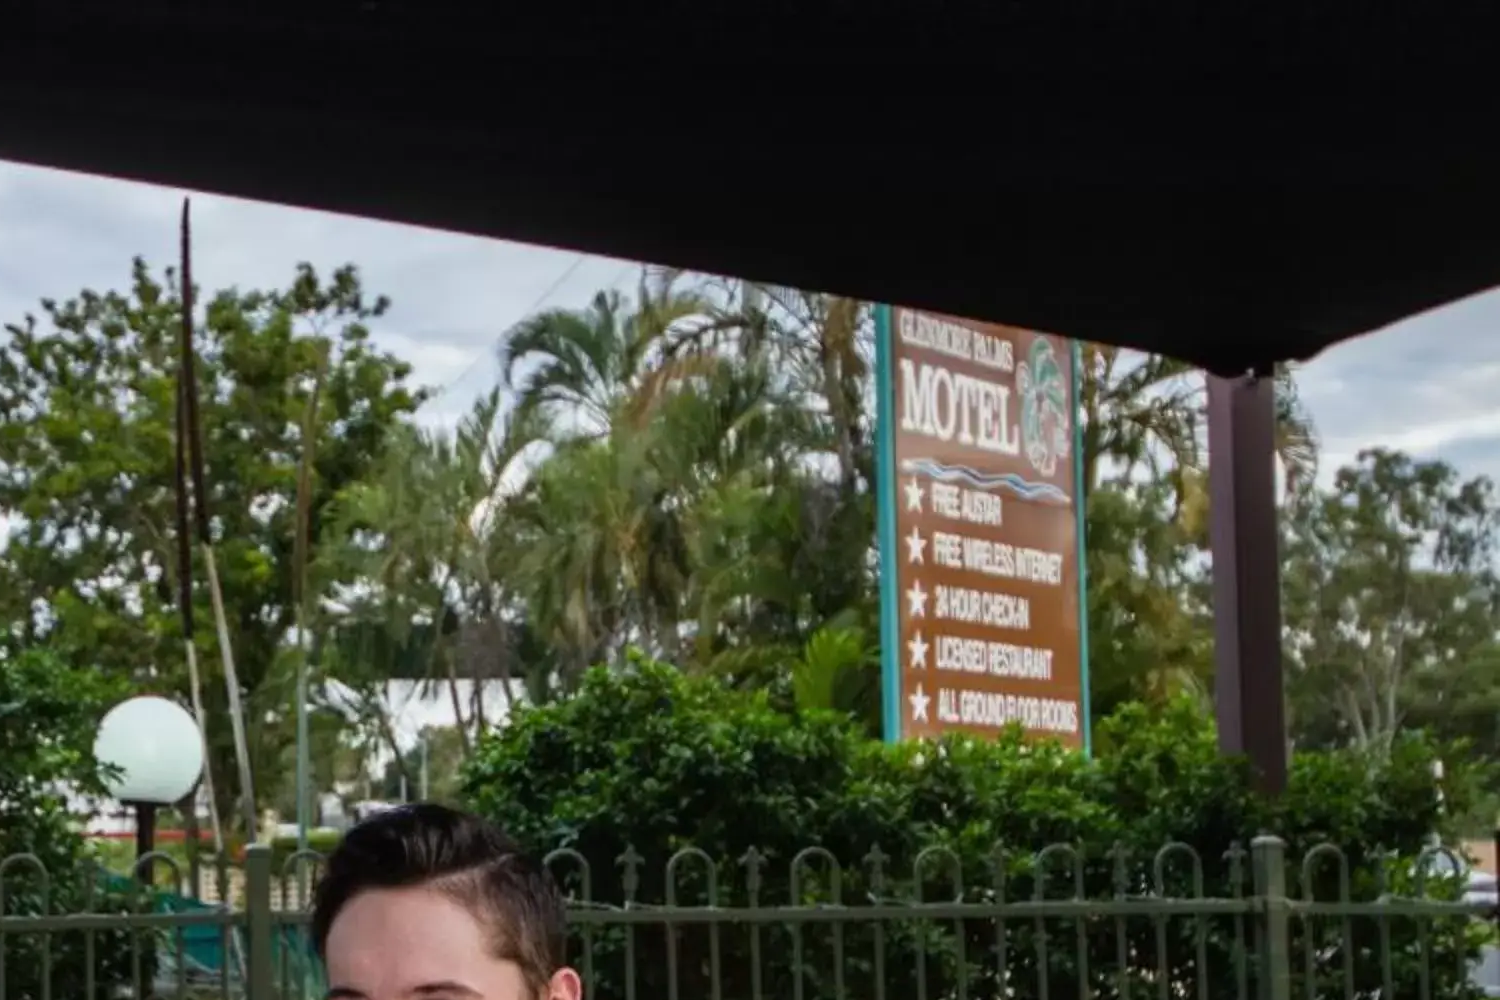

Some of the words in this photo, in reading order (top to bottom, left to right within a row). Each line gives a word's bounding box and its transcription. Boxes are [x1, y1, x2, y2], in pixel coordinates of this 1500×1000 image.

[973, 331, 1014, 373] PALMS
[899, 358, 1020, 455] MOTEL
[931, 481, 961, 519] FREE
[962, 488, 1002, 525] AUSTAR
[932, 531, 962, 568] FREE
[963, 536, 1015, 577] WIRELESS
[1015, 547, 1063, 585] INTERNET
[949, 586, 980, 622] HOUR
[934, 635, 987, 673] LICENSED
[988, 641, 1053, 680] RESTAURANT
[938, 687, 959, 723] ALL
[960, 689, 1004, 726] GROUND
[1041, 698, 1078, 733] ROOMS
